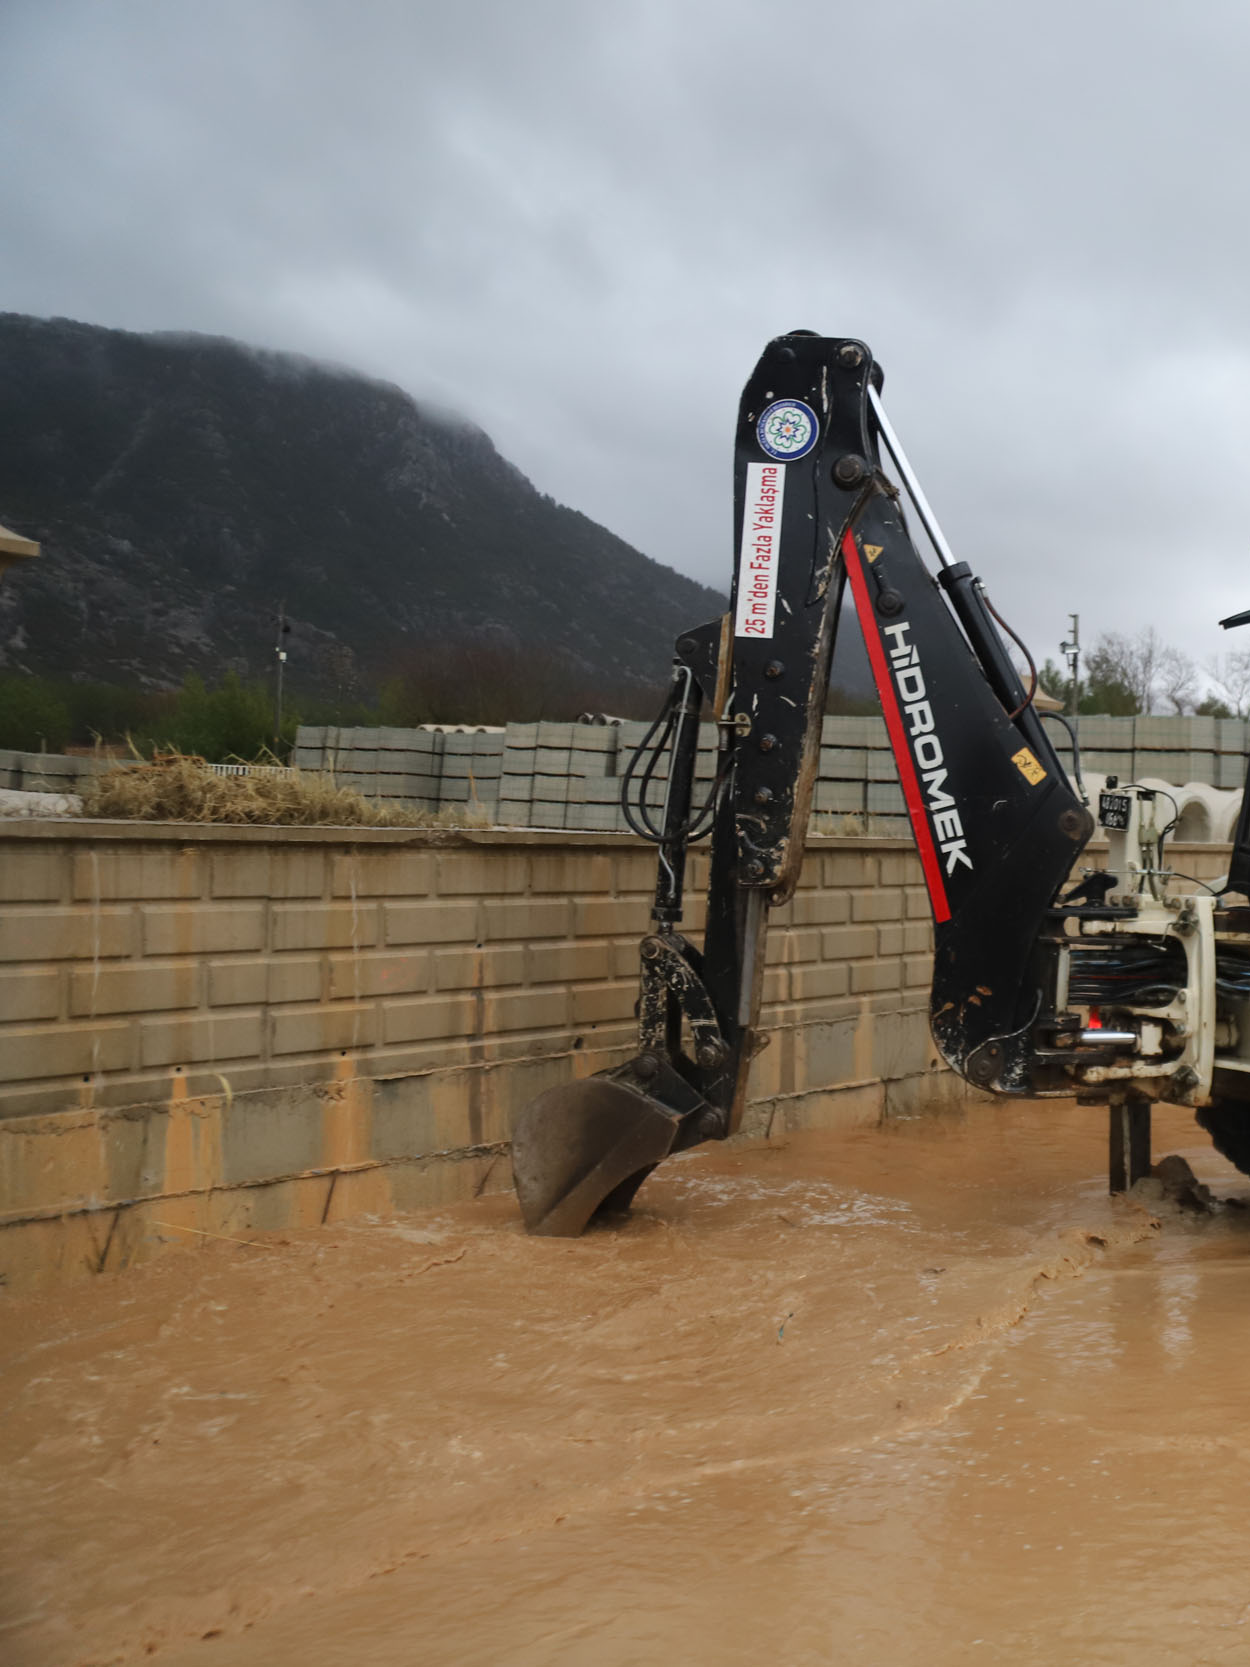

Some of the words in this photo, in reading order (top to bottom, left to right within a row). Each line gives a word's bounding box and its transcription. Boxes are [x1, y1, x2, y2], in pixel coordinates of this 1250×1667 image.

[752, 467, 780, 531] Yaklaşma
[749, 535, 773, 570] Fazla
[744, 618, 766, 634] 25
